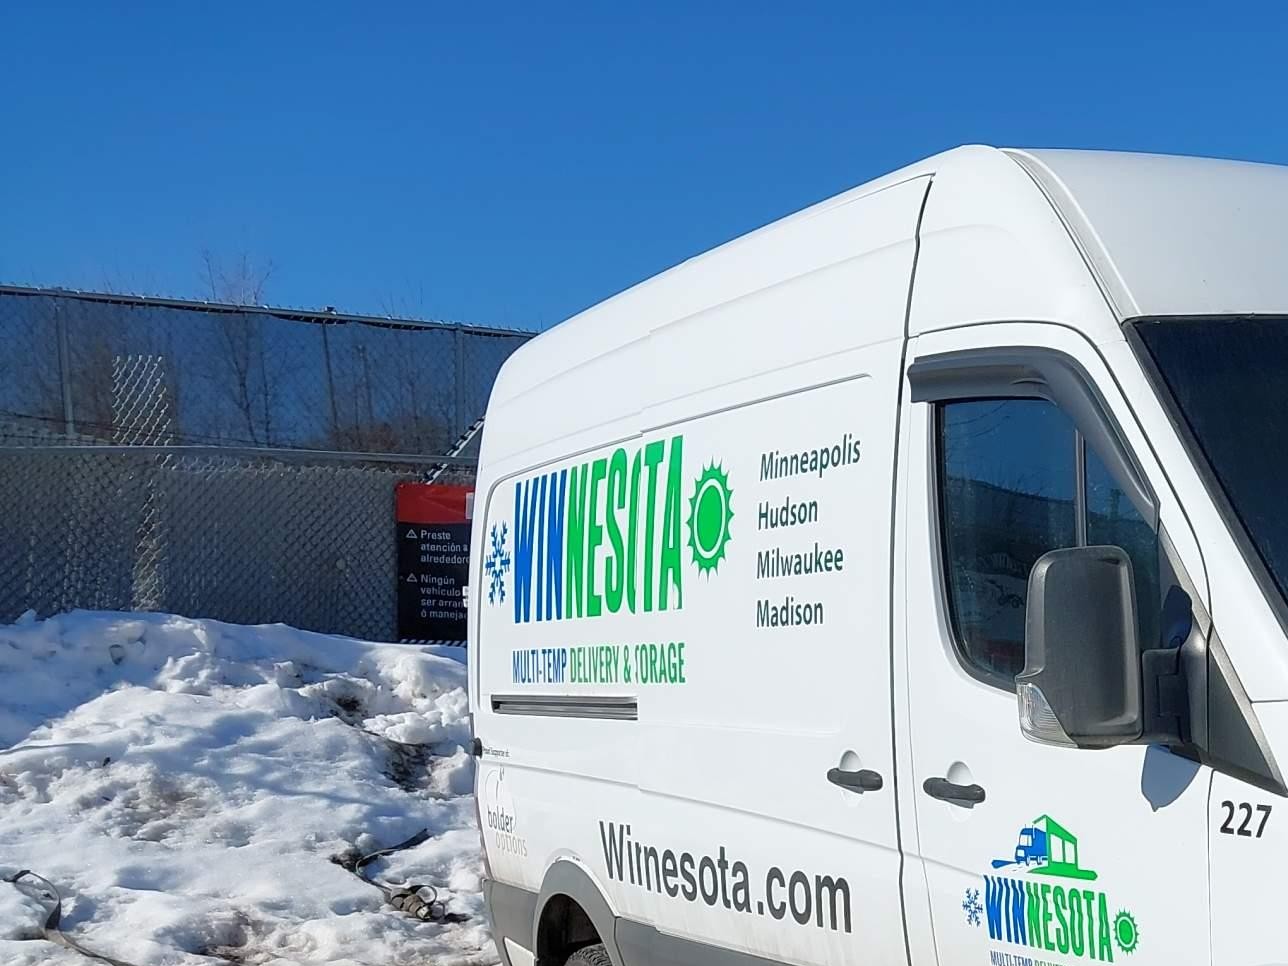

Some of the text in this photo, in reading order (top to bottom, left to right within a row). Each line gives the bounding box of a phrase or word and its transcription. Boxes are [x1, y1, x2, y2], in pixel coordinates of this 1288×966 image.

[760, 433, 861, 482] Minneapolis
[758, 496, 818, 531] Hudson
[420, 529, 451, 540] Preste
[420, 542, 461, 552] atención
[756, 543, 844, 579] Milwaukee
[420, 574, 455, 586] Ningún
[420, 598, 436, 607] ser
[756, 598, 824, 629] Madison
[512, 648, 567, 684] MULTI-TEMP
[569, 644, 621, 684] DELIVERY
[623, 644, 632, 684] &
[487, 804, 514, 834] bolder
[1220, 800, 1273, 838] 227
[495, 831, 528, 858] options
[983, 874, 1115, 964] WINNESOTA
